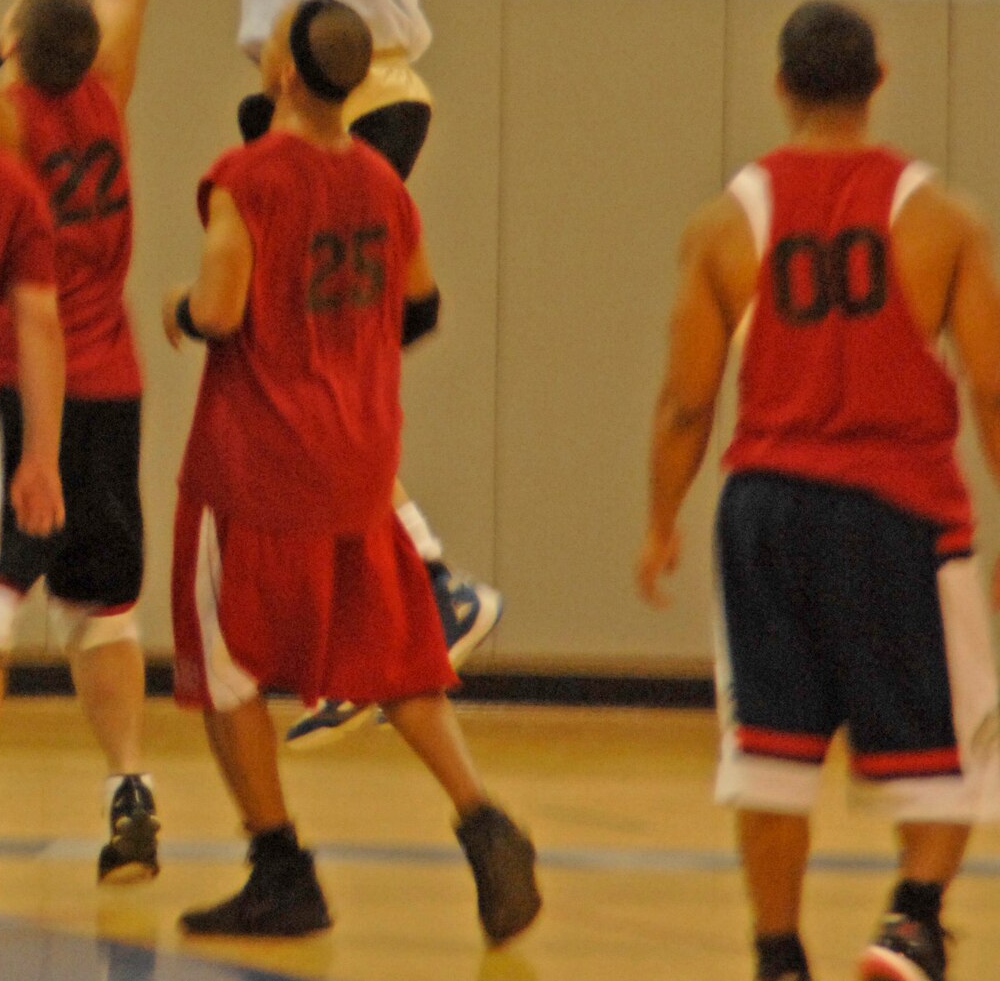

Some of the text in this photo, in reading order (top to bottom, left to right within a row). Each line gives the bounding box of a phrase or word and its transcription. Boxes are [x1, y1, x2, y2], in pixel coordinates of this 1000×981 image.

[41, 137, 131, 227] 22
[308, 223, 388, 313] 25
[772, 226, 886, 328] 00
